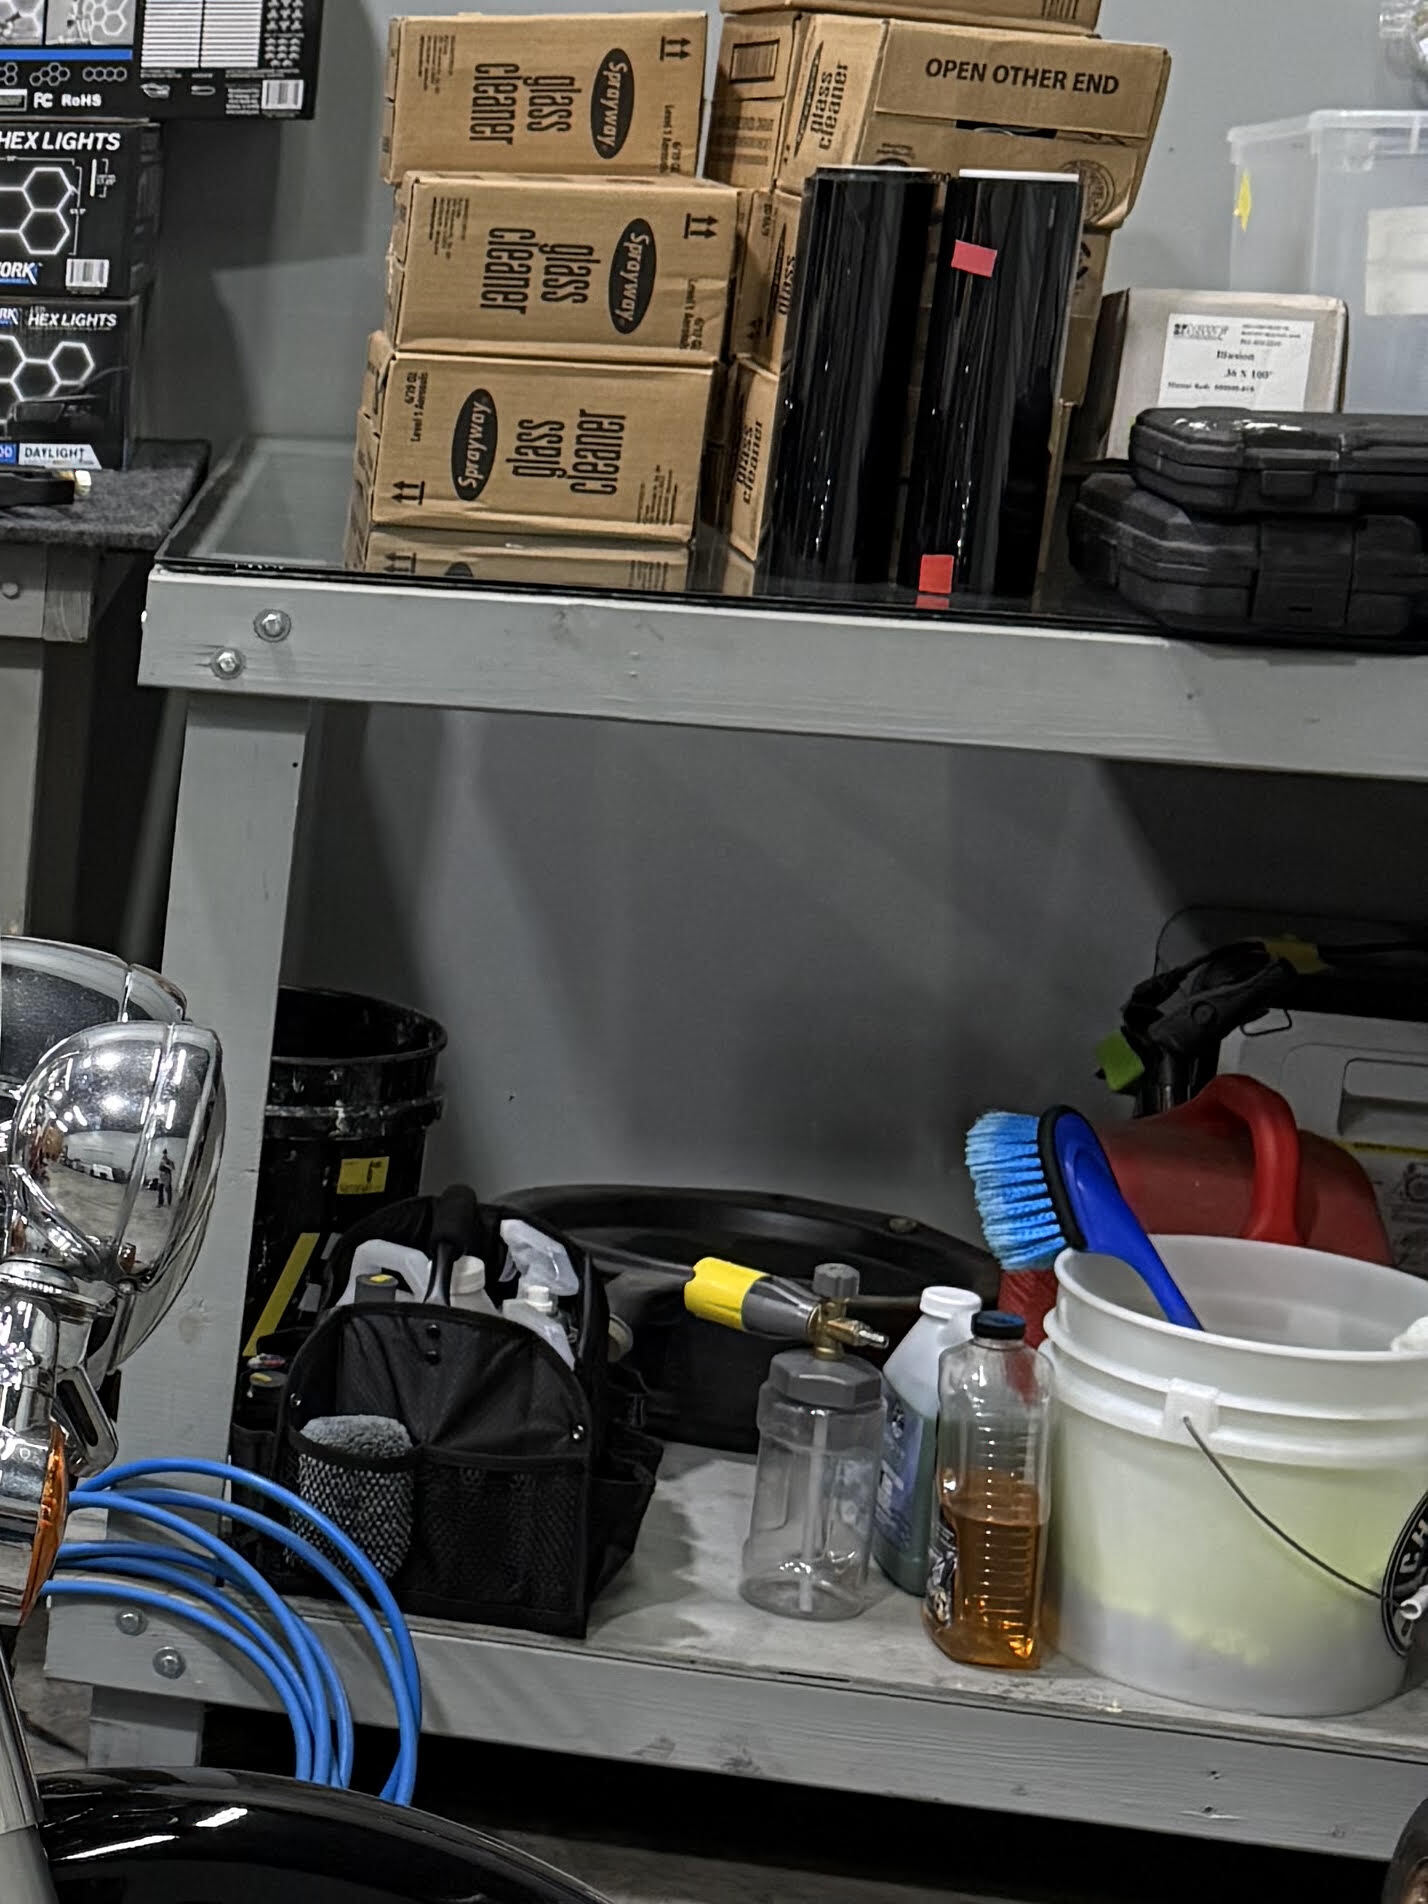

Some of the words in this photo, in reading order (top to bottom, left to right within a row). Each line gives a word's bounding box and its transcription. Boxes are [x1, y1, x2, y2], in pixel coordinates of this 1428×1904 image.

[61, 93, 102, 107] RoHS
[469, 62, 520, 146] cleaner
[523, 75, 582, 133] glass
[596, 61, 628, 147] Sprayway
[818, 62, 849, 152] cleaner
[925, 58, 986, 83] OPEN
[991, 64, 1067, 90] OTHER
[1072, 71, 1121, 95] END
[42, 132, 121, 151] LIGHTS
[480, 227, 536, 315] cleaner
[539, 243, 601, 304] glass
[615, 232, 650, 322] Sprayway
[28, 313, 61, 327] HEX
[61, 313, 117, 328] LIGHTS
[24, 447, 85, 460] DAYLIGHT
[457, 399, 493, 489] Sprayway
[505, 419, 567, 480] glass
[566, 409, 626, 496] cleaner
